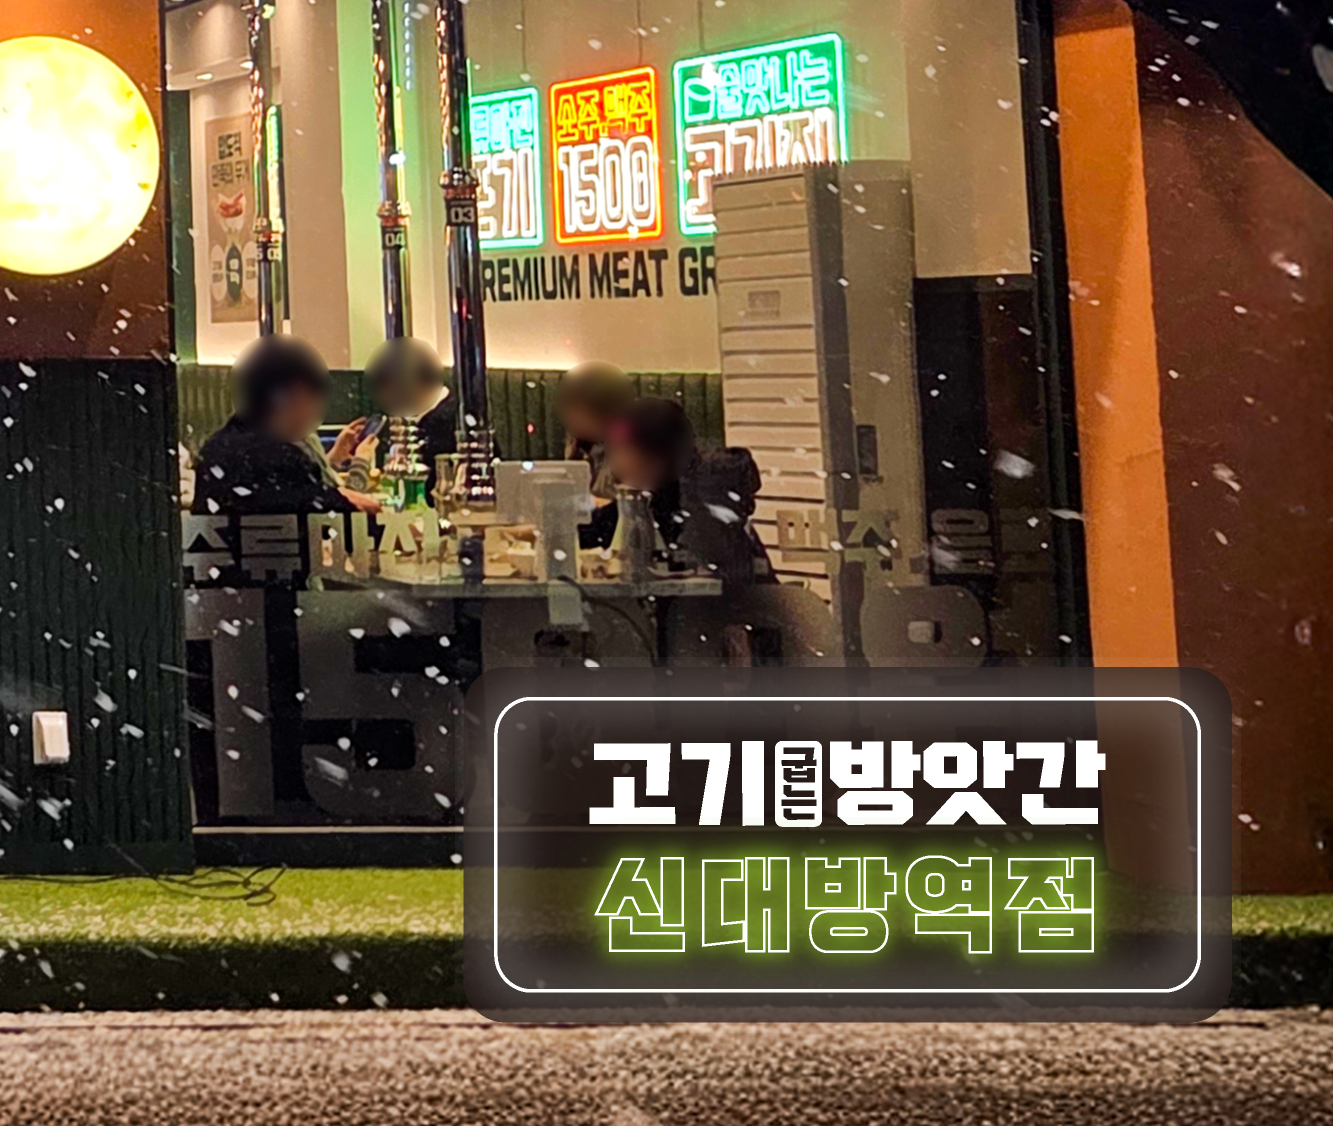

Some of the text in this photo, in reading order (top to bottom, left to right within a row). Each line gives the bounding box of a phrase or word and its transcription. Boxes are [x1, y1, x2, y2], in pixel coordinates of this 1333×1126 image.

[556, 135, 655, 234] 1500
[450, 206, 475, 224] 03
[385, 232, 406, 248] 04
[482, 253, 582, 303] REMIUM
[588, 248, 669, 300] MEAT
